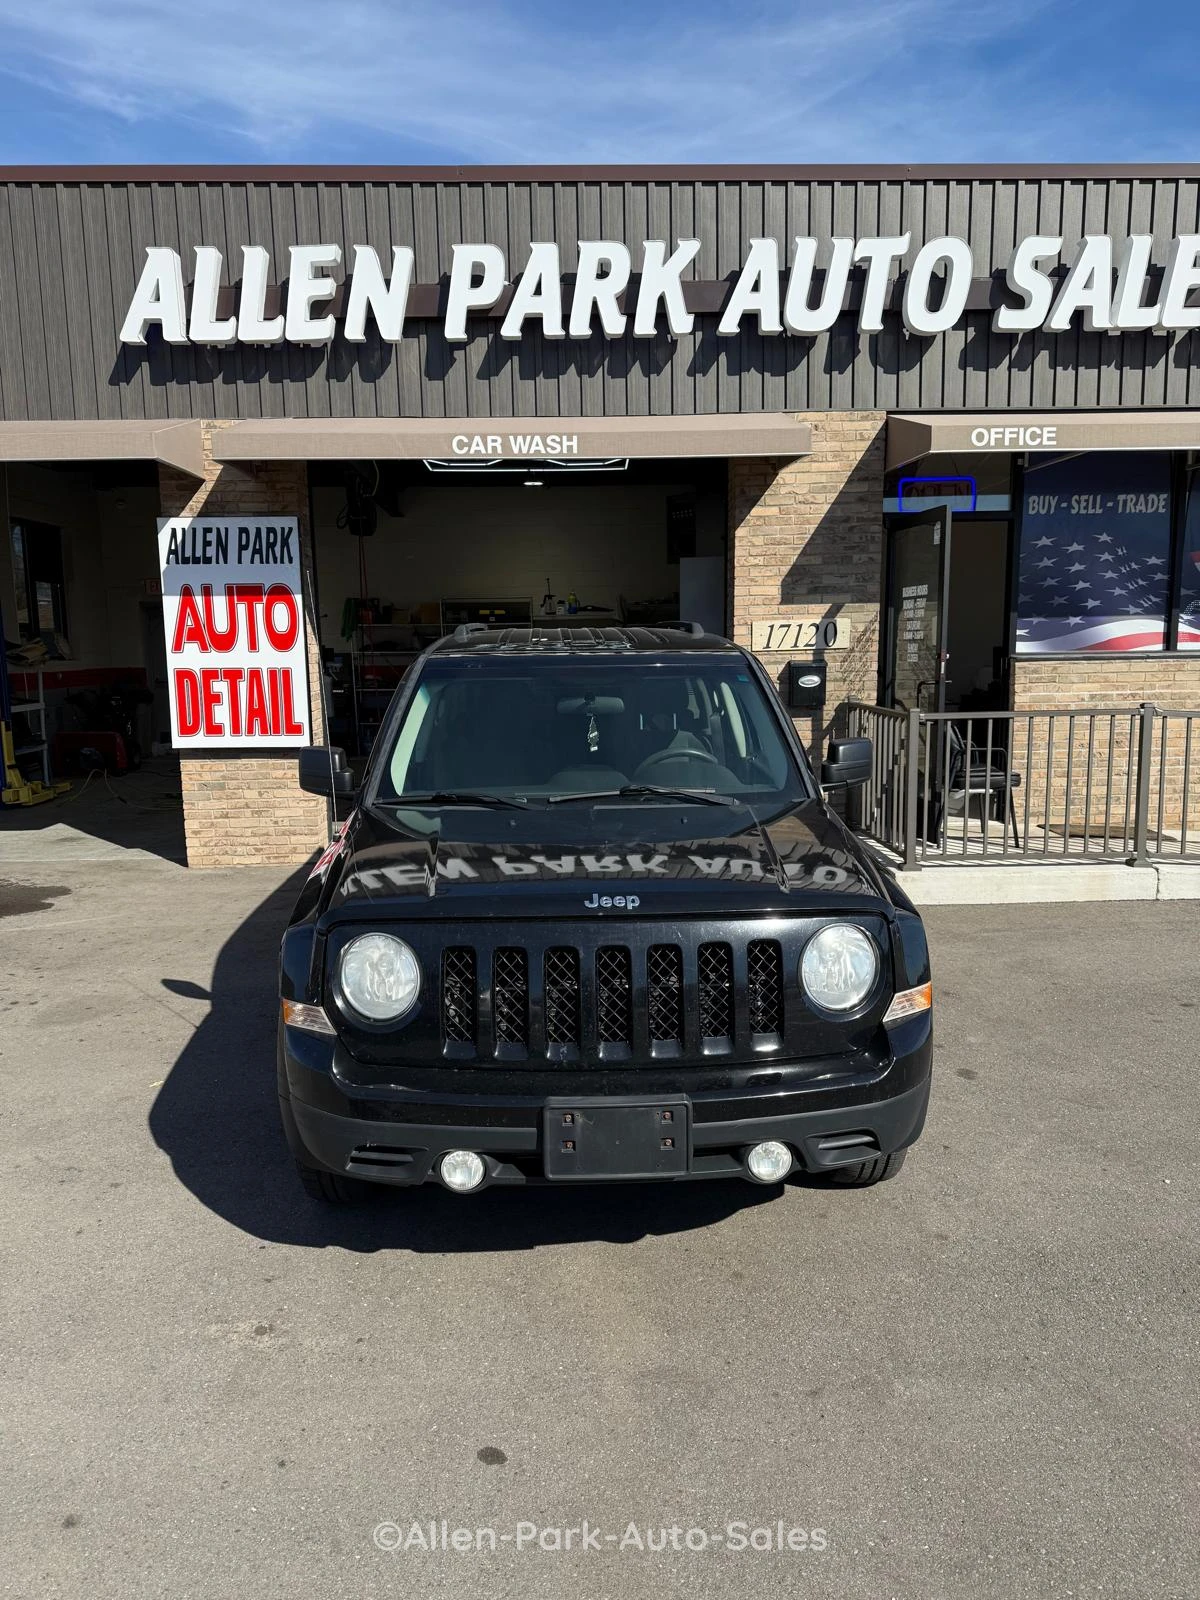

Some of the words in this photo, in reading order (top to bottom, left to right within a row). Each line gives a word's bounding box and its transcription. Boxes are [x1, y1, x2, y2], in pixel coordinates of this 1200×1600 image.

[119, 244, 414, 345] ALLEN
[444, 238, 701, 342] PARK
[716, 231, 973, 336] AUTO
[452, 434, 503, 455] CAR
[508, 434, 578, 455] WASH
[971, 427, 1057, 447] OFFICE
[1028, 495, 1058, 515] BUY
[1070, 494, 1103, 515] SELL
[1117, 493, 1168, 514] TRADE
[166, 527, 229, 565] ALLEN
[237, 526, 294, 565] PARK
[171, 583, 300, 653] AUTO
[762, 621, 838, 650] 17120
[173, 668, 304, 737] DETAIL
[584, 893, 641, 910] Jeep
